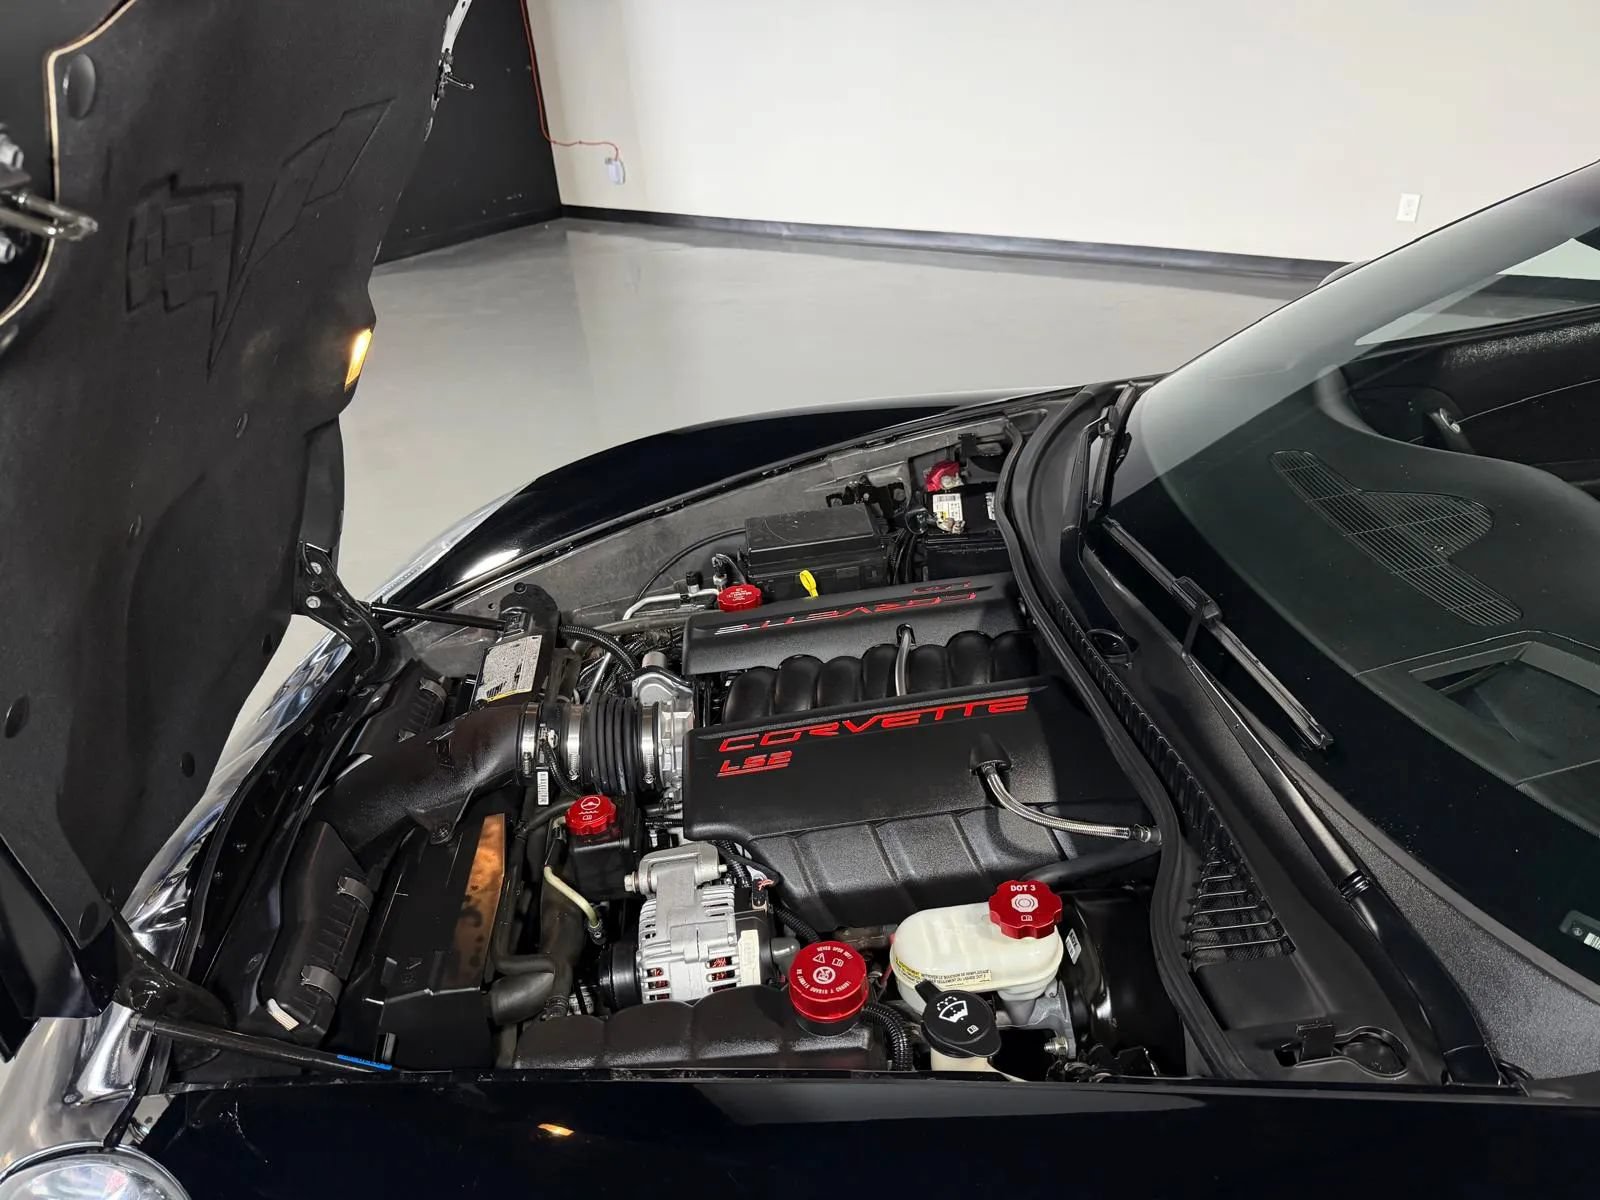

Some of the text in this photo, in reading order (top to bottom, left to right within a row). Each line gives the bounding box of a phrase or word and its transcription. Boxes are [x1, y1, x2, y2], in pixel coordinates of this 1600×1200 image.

[719, 695, 1028, 752] CORVETTE
[718, 751, 792, 775] LS2
[1010, 884, 1028, 892] DOT
